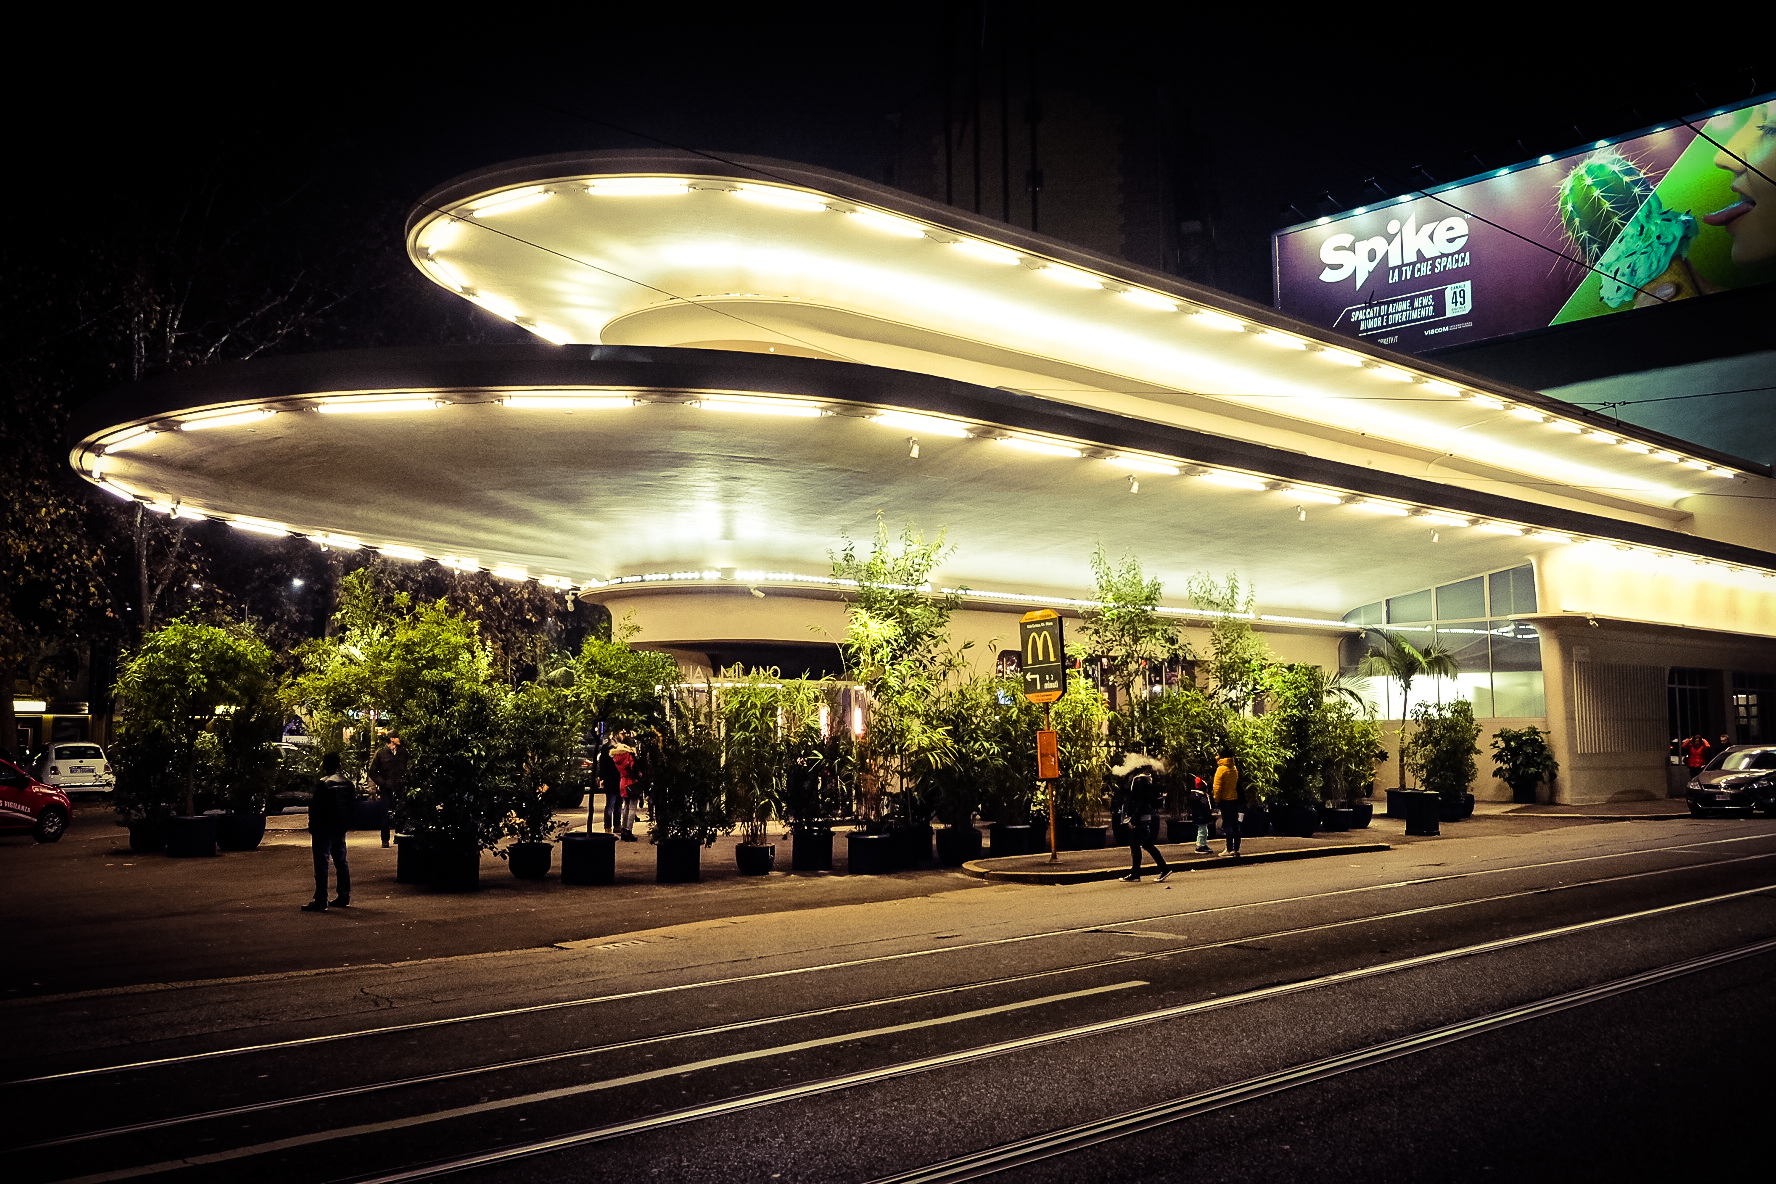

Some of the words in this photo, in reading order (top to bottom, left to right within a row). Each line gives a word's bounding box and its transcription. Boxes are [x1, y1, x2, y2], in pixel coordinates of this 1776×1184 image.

[1318, 211, 1469, 291] Spike
[1388, 268, 1399, 284] LA
[1401, 265, 1413, 280] TV
[1414, 260, 1432, 278] CHE
[1434, 251, 1470, 273] SPACCA
[1350, 306, 1380, 322] SPACCATI
[1380, 304, 1388, 315] DI
[1413, 294, 1435, 308] NEWS,
[1451, 288, 1466, 307] 49
[1383, 315, 1388, 326] E
[1388, 305, 1435, 324] DIVERTIMENTO.
[4, 800, 31, 813] VIGILANZA
